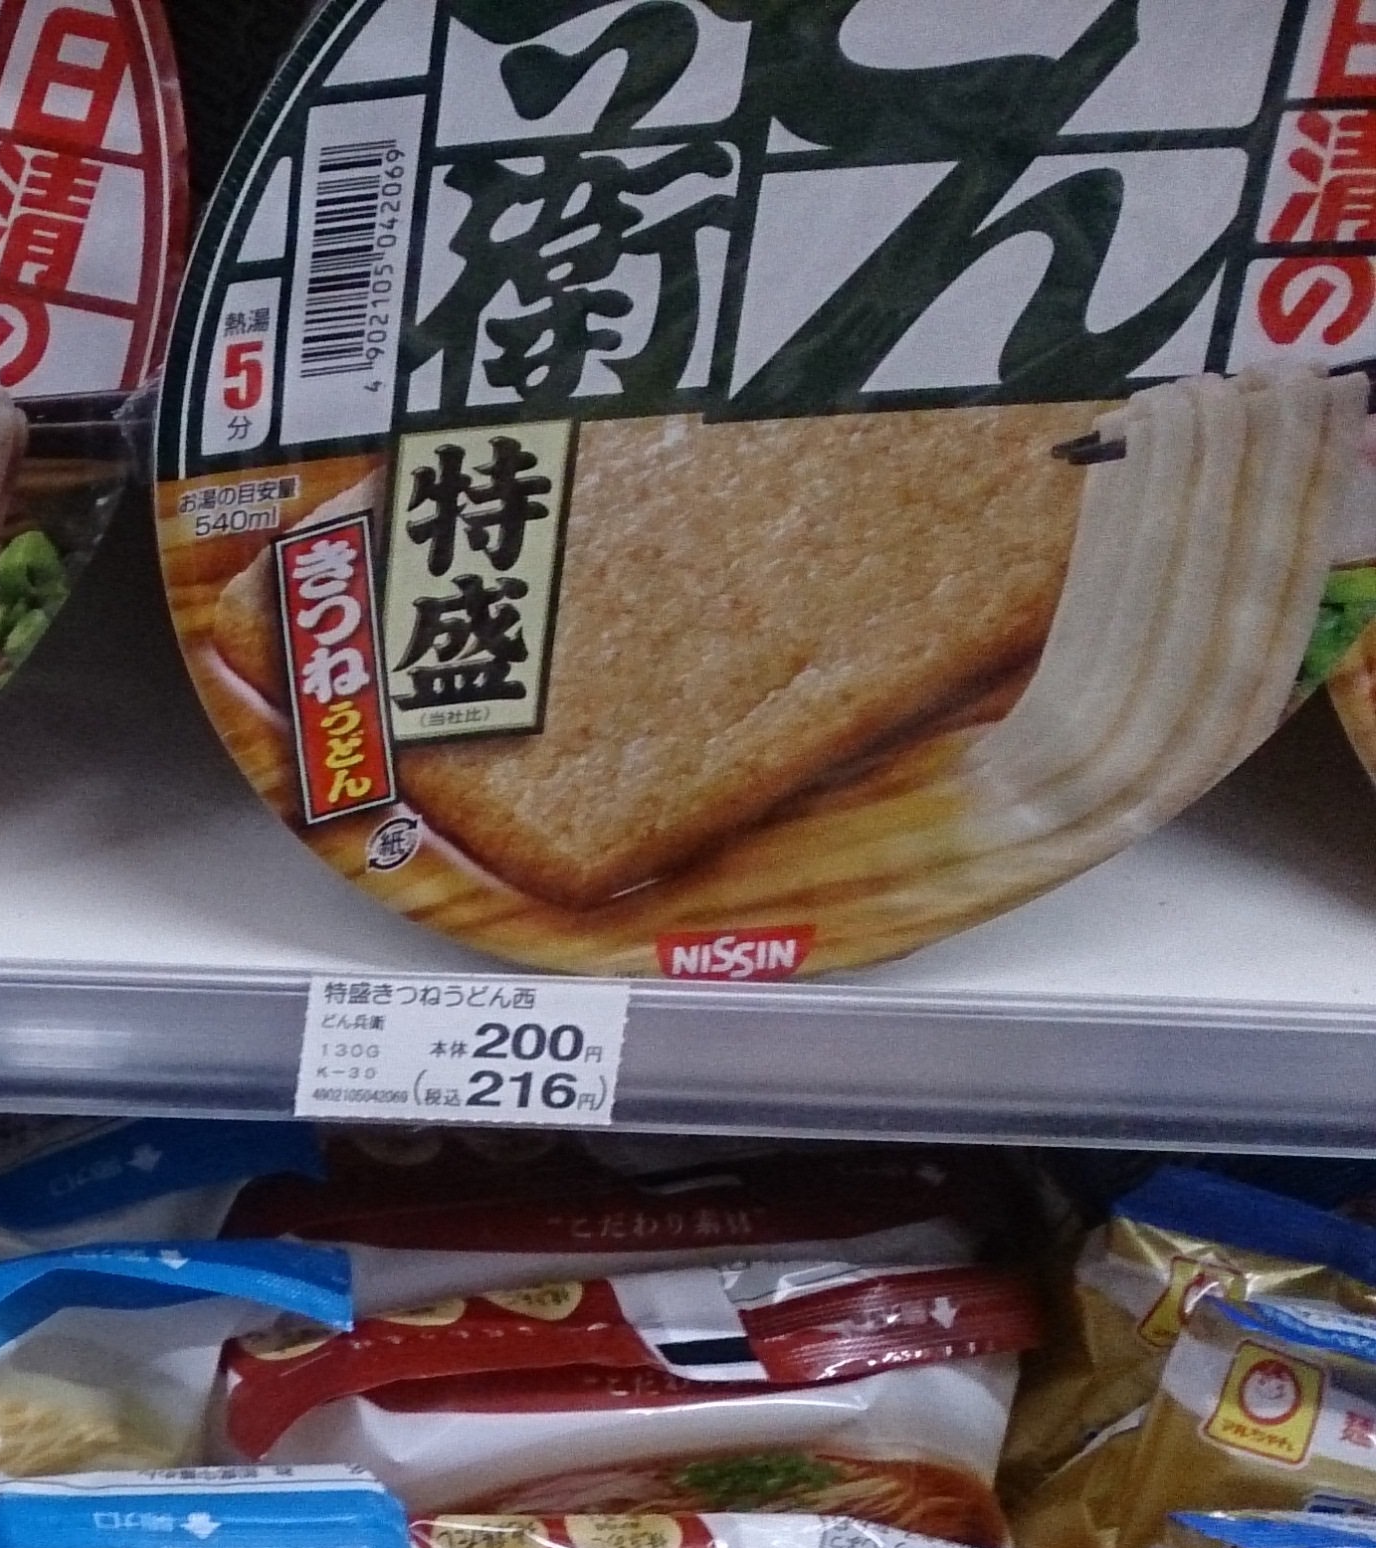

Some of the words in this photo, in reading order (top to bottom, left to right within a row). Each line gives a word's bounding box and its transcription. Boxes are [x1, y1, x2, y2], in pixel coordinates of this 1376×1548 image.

[223, 307, 271, 338] 熱湯
[222, 340, 265, 412] 5
[178, 476, 301, 514] お湯の目安量
[193, 505, 279, 537] 540ml
[390, 436, 552, 712] 特盛
[293, 538, 371, 803] きつねうどん
[670, 936, 798, 980] NISSIN
[324, 981, 536, 1010] 特盛きつねうどん西
[321, 1013, 386, 1032] どん兵衛
